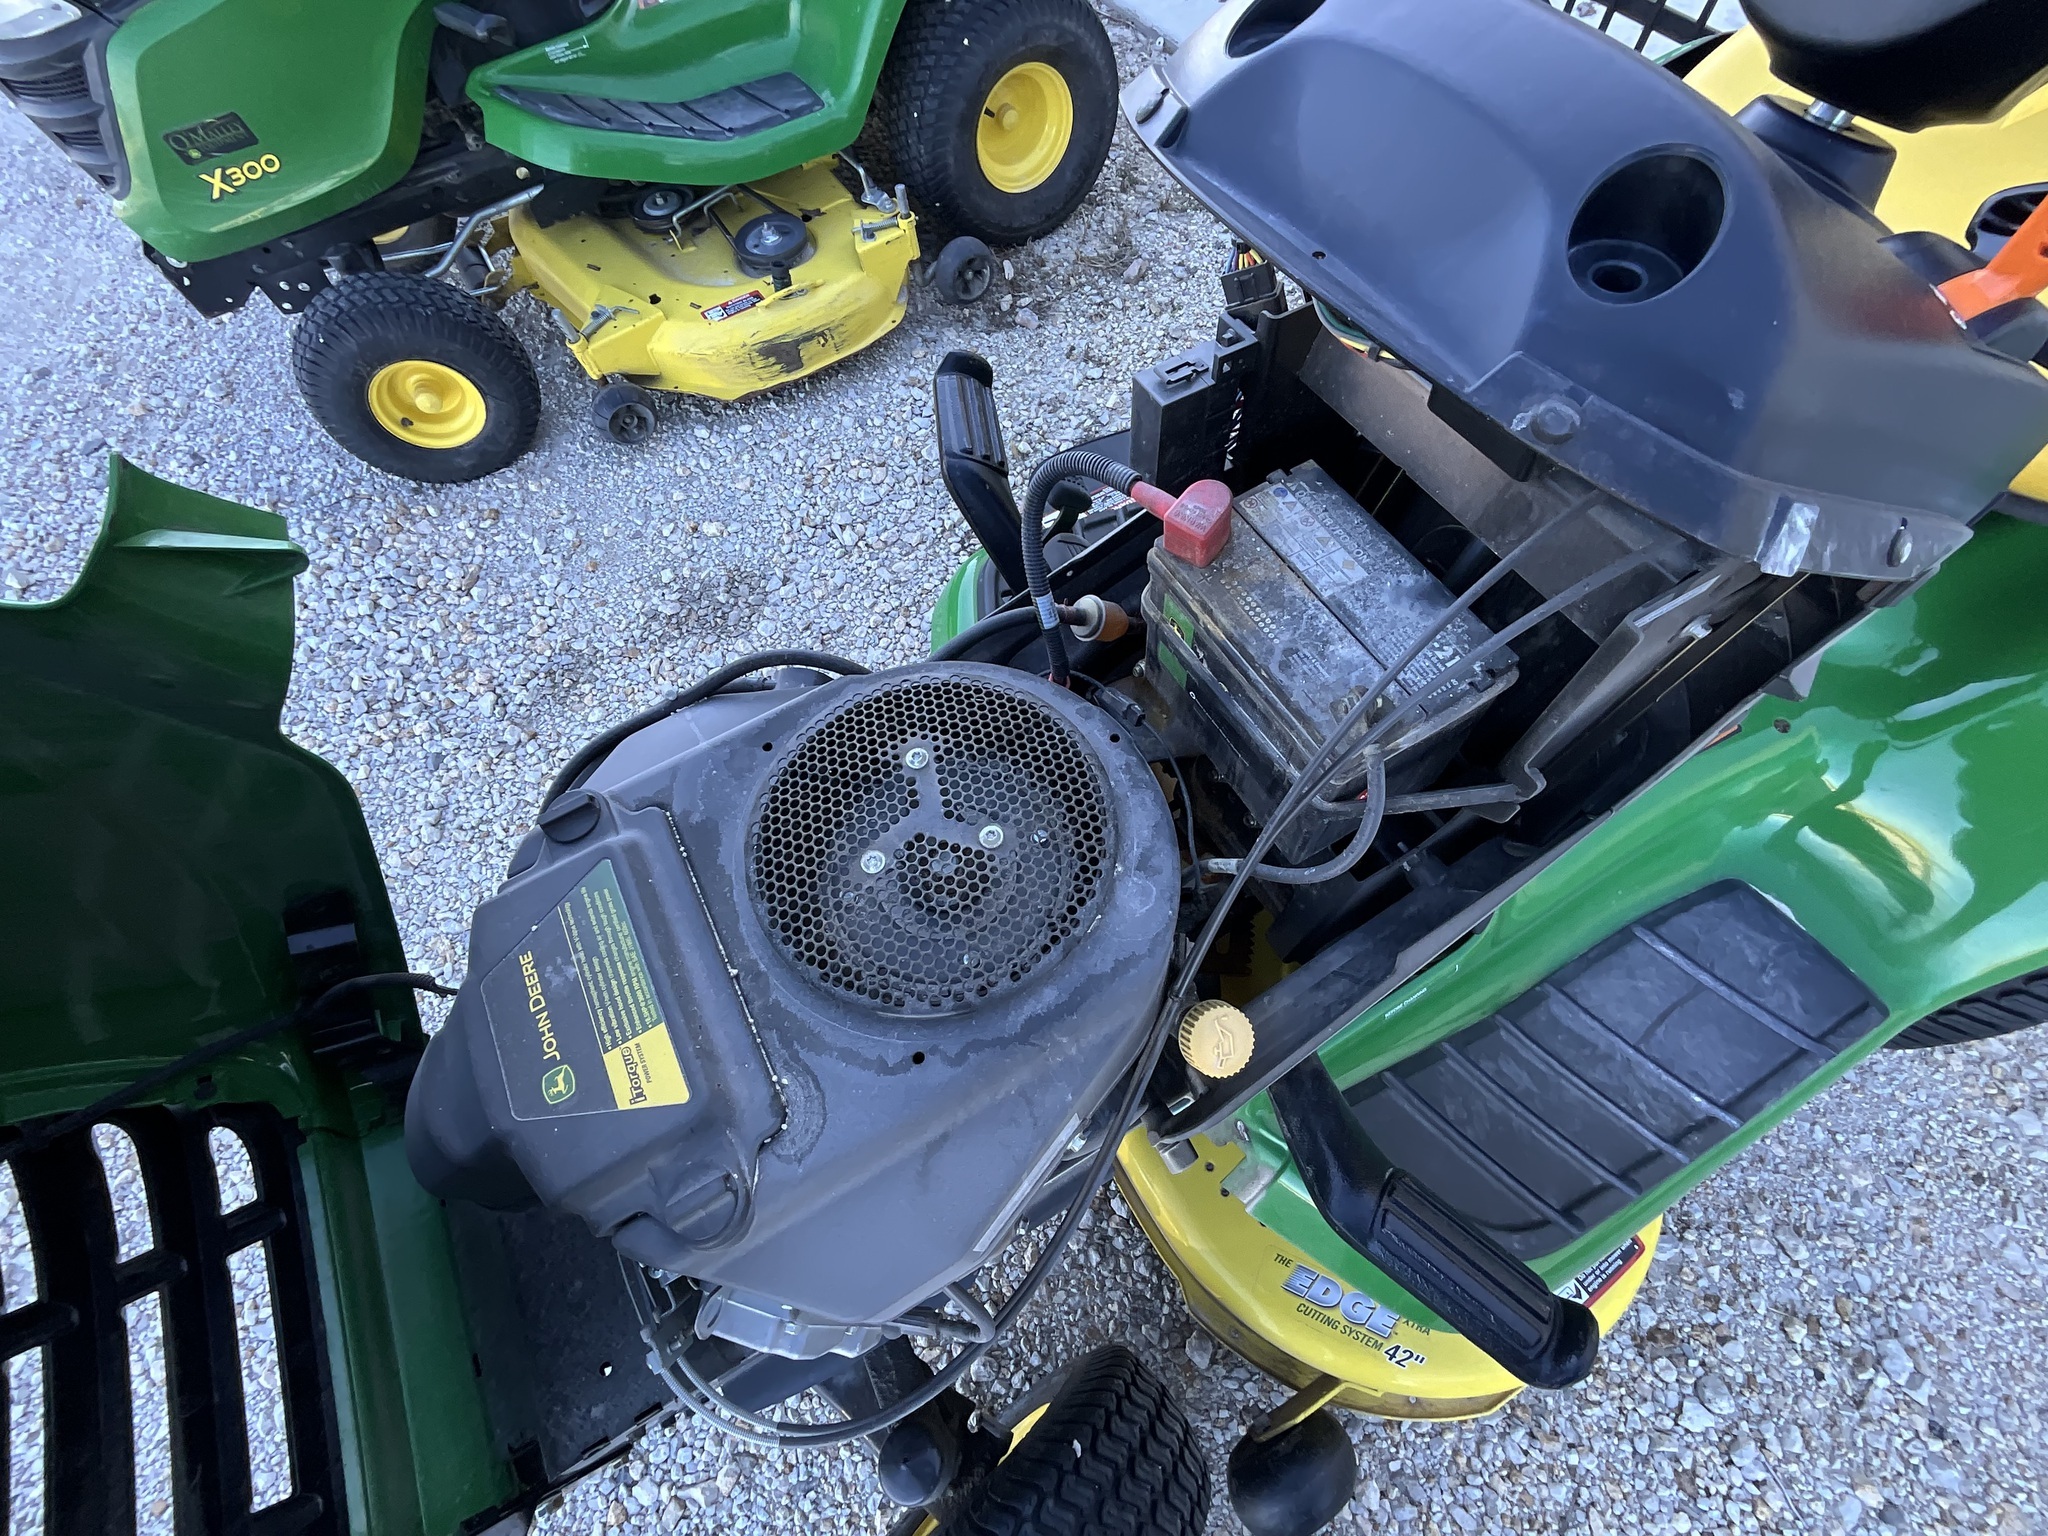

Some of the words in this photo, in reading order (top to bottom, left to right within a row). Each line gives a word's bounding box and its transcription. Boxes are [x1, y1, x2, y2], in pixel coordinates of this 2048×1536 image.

[198, 153, 281, 200] X300
[519, 950, 547, 1013] DEERE
[609, 977, 620, 996] design
[536, 1011, 561, 1061] JOHN
[634, 1043, 648, 1064] SYSTEM
[621, 1046, 647, 1105] iTorque
[637, 1064, 653, 1084] POWER
[1273, 1253, 1294, 1268] THE
[1606, 1258, 1622, 1275] running
[1281, 1262, 1401, 1339] EDGE
[1296, 1302, 1341, 1331] CUTTING
[1340, 1324, 1384, 1352] SYSTEM
[1384, 1343, 1427, 1369] 42"
